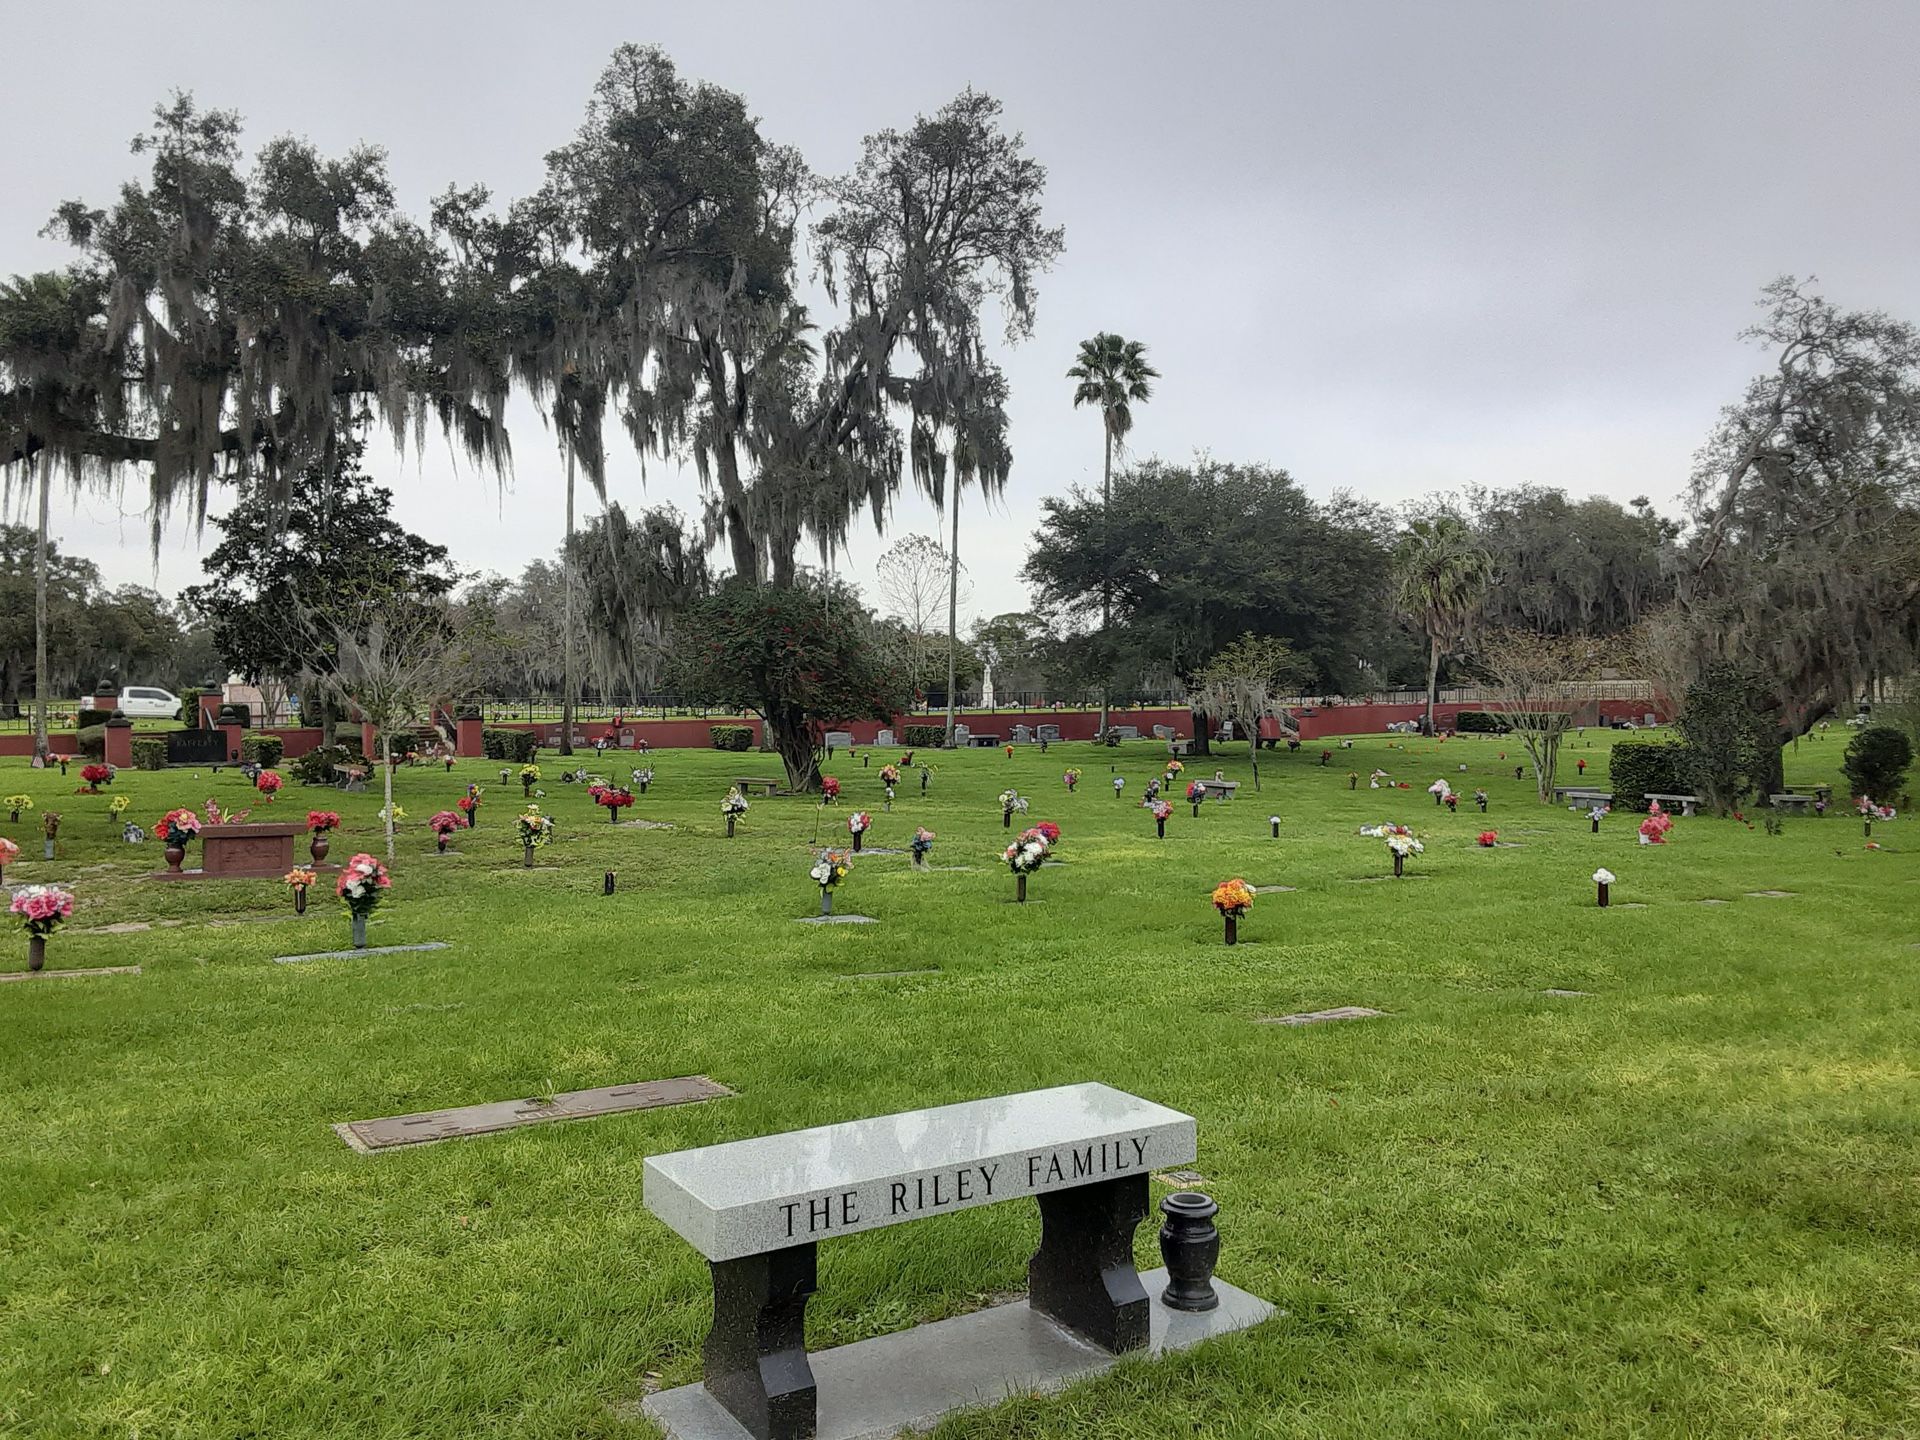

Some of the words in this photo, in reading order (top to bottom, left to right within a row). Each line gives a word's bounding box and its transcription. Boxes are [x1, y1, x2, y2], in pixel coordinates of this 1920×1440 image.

[779, 1191, 860, 1238] THE
[890, 1163, 1000, 1215] RILEY
[1026, 1135, 1150, 1187] FAMILY
